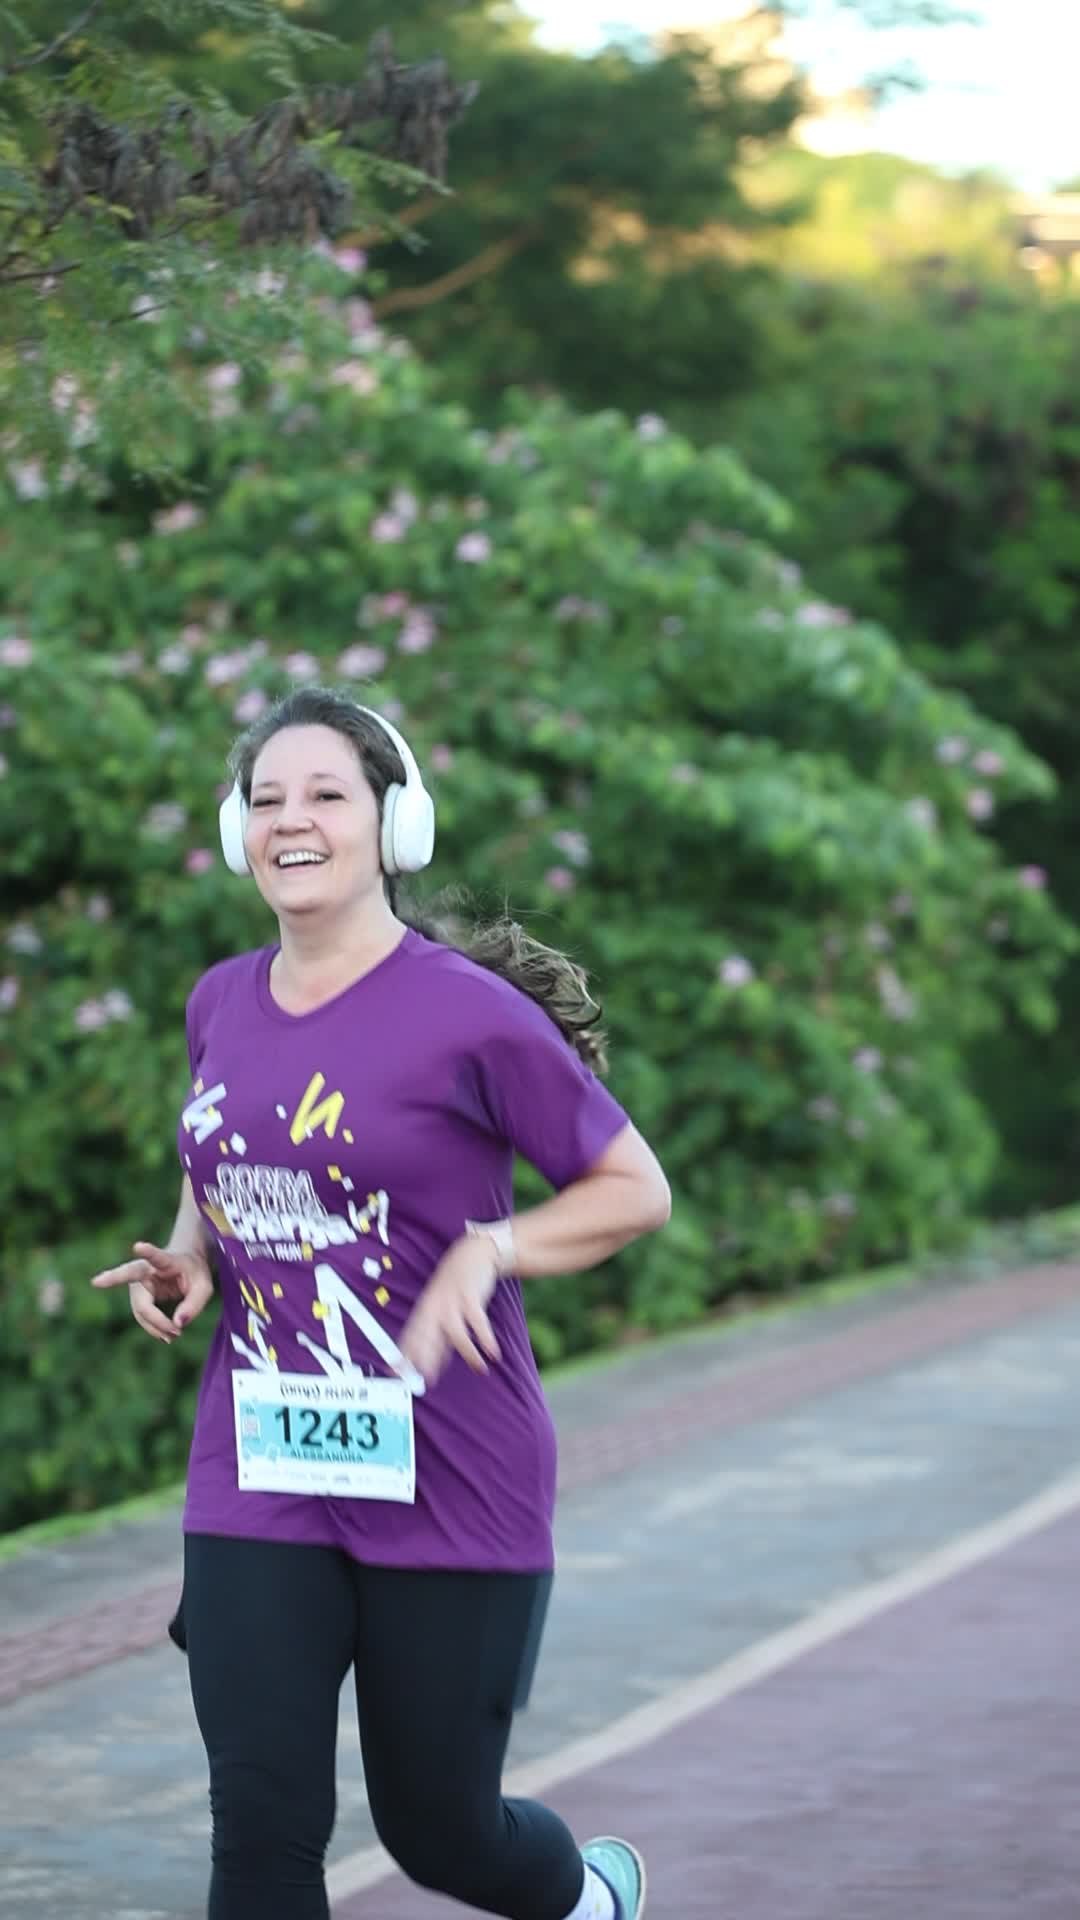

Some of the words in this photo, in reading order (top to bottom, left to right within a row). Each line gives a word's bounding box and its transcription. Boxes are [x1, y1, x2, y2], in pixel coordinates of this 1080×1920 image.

[325, 1385, 355, 1400] RUN
[274, 1405, 380, 1451] 1243
[289, 1449, 364, 1464] ALESSANDRA
